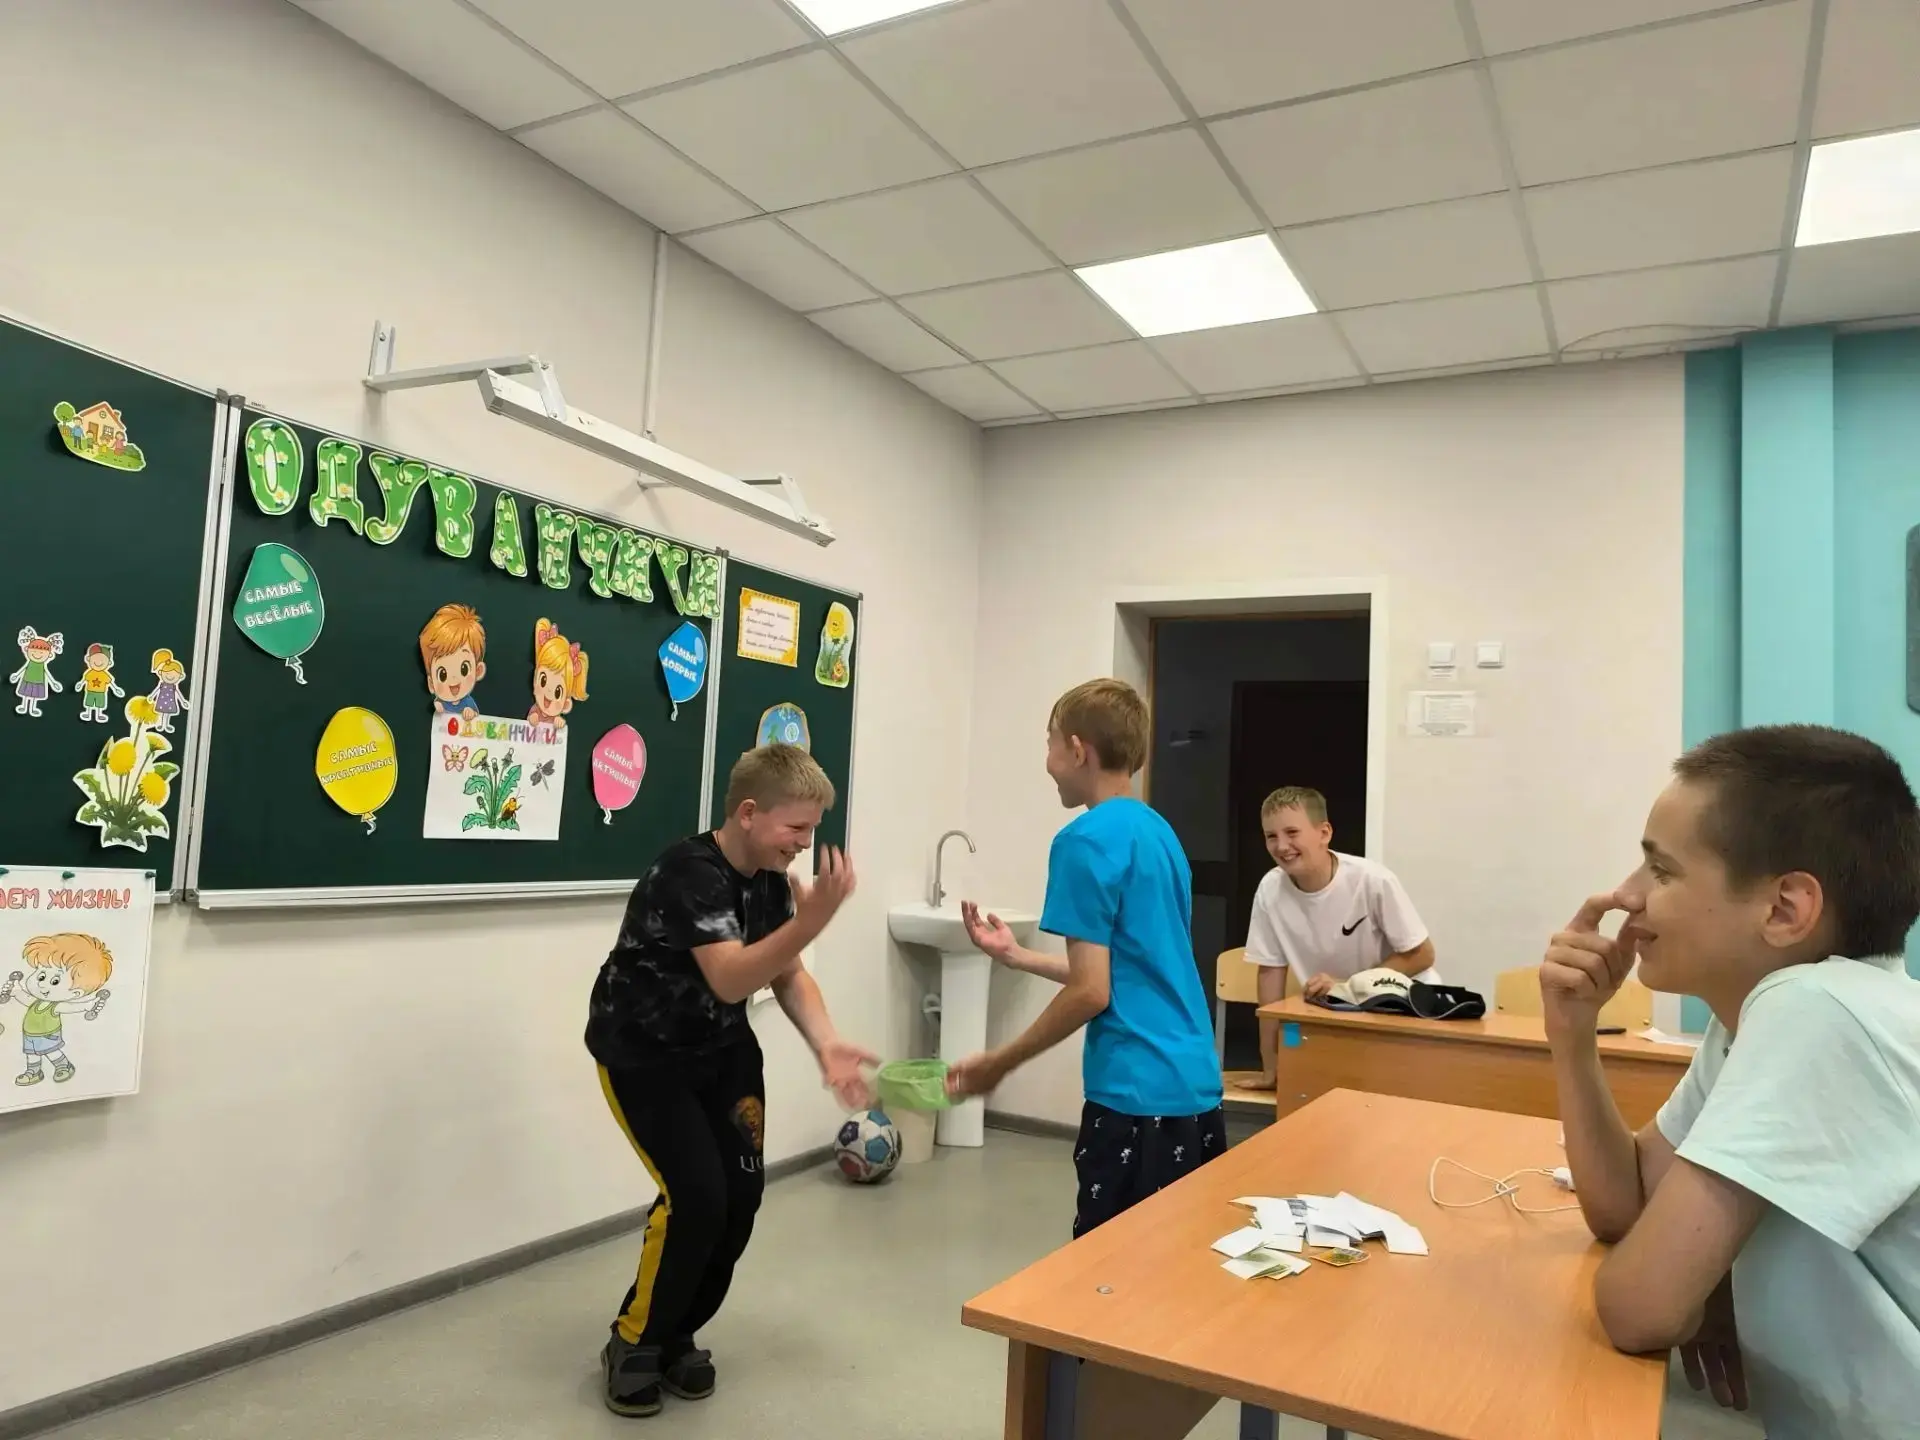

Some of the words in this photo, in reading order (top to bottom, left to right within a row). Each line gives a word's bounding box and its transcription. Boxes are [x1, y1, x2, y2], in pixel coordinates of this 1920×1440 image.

[245, 580, 303, 603] САМЫЕ
[245, 601, 314, 628] ВЕСЁЛЫЕ
[668, 642, 697, 666] САМЫЕ
[330, 741, 378, 763] САМЫЕ
[47, 888, 131, 910] ЖИЗНЬ!
